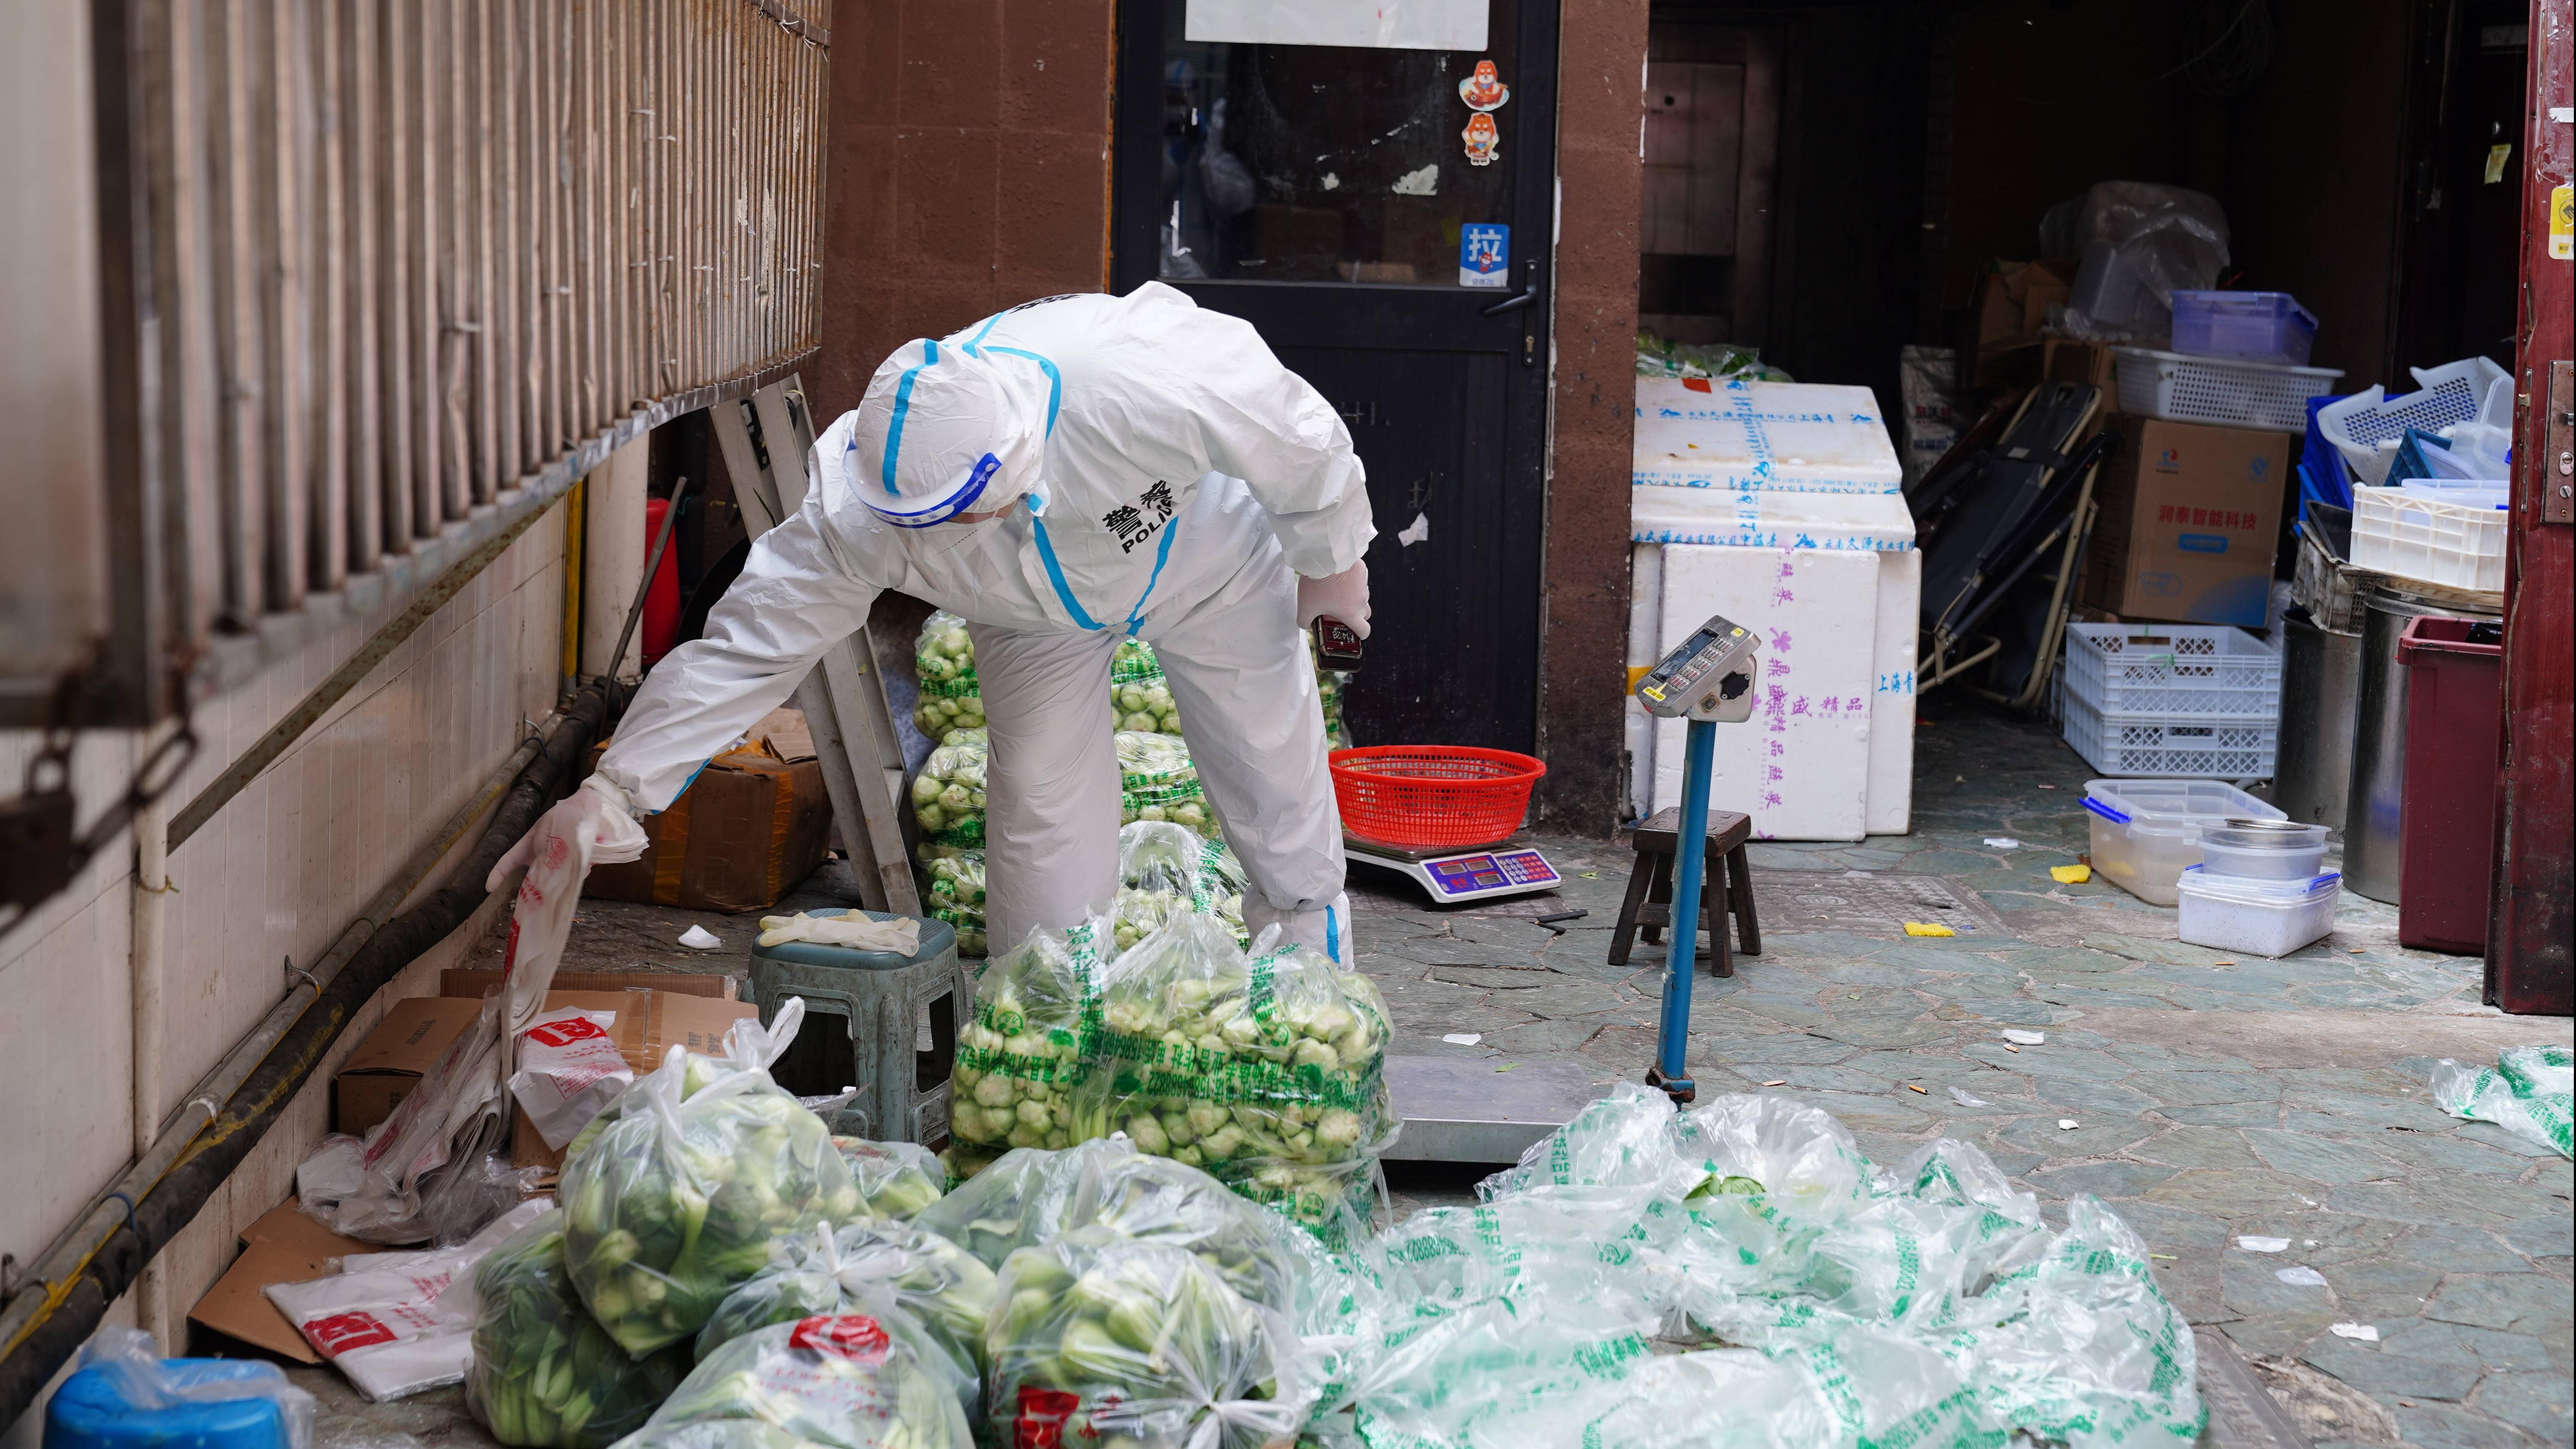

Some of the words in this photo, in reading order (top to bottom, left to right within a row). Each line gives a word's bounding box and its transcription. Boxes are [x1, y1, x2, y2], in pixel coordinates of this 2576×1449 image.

[1468, 228, 1502, 262] 拉
[1102, 480, 1172, 540] 警察
[2159, 505, 2256, 530] 润泰智能科技
[1878, 671, 1912, 694] 上海青
